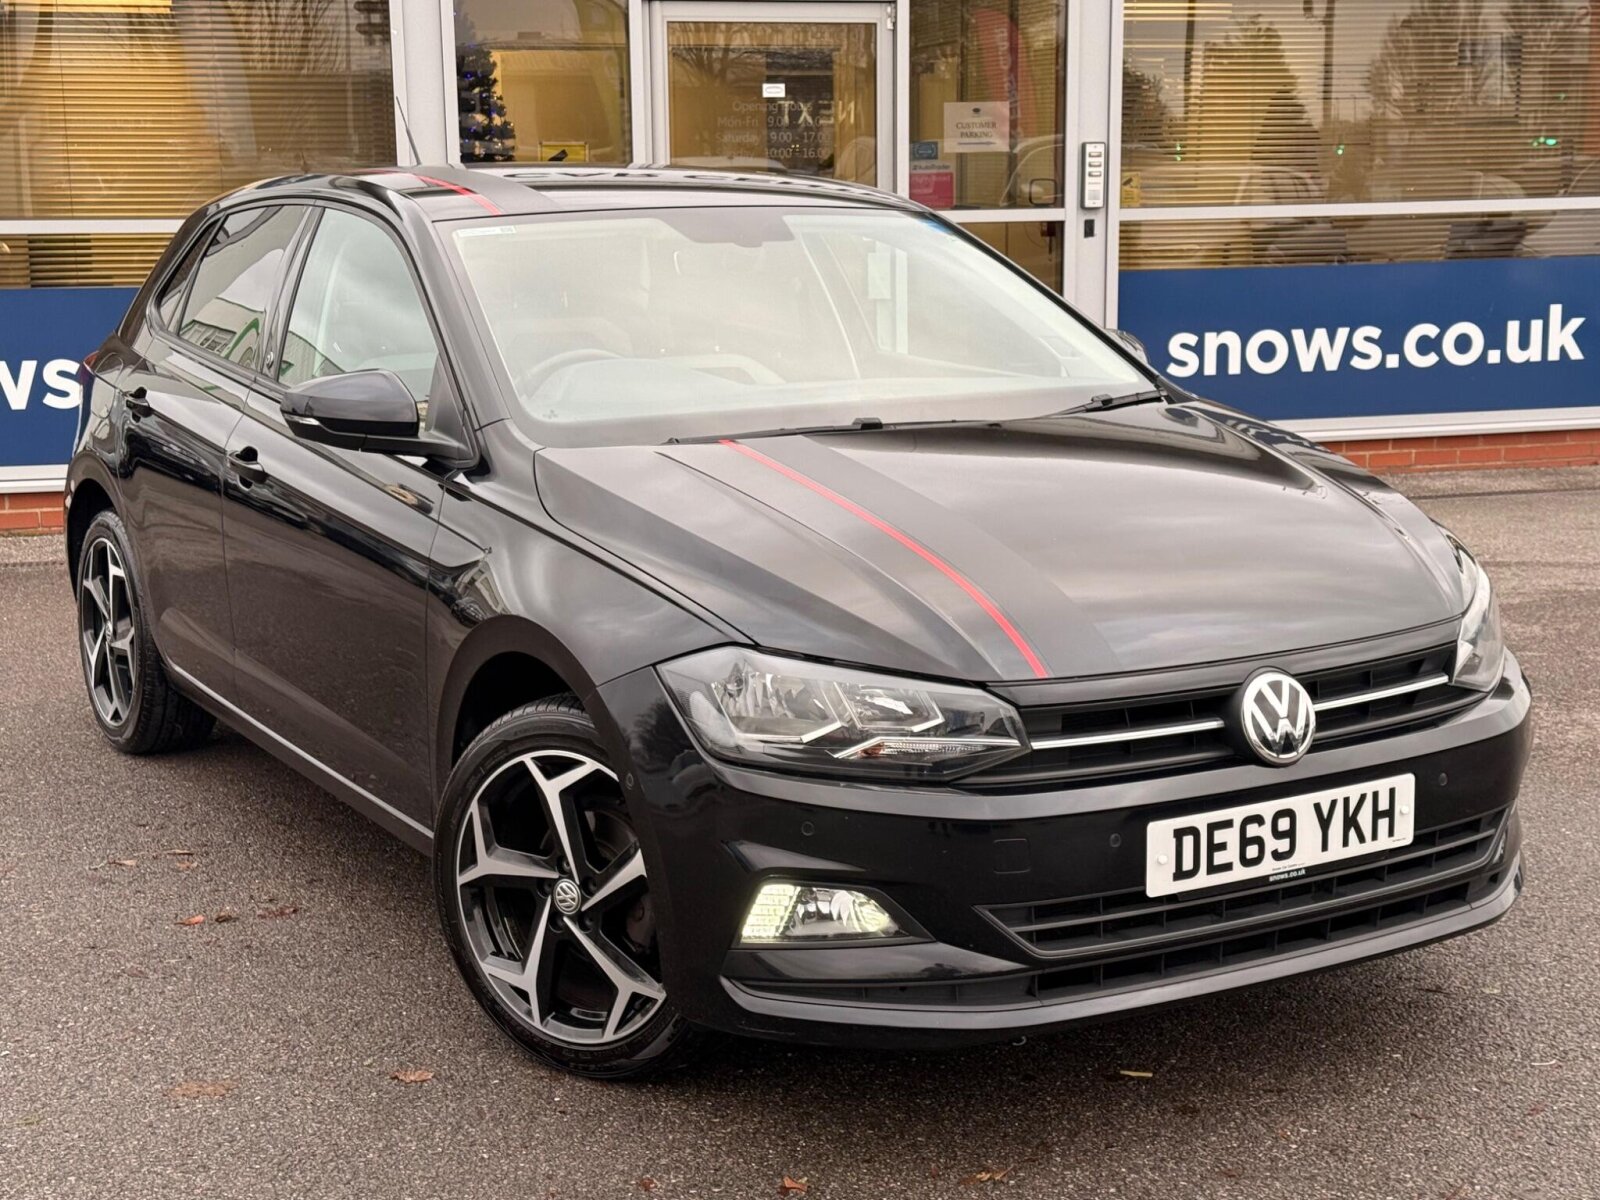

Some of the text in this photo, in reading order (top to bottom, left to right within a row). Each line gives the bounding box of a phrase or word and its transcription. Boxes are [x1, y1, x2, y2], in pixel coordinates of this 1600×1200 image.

[732, 100, 778, 114] Opening
[717, 116, 759, 127] Mon-Fri
[955, 121, 997, 130] CUSTOMER
[715, 132, 760, 145] Saturday
[769, 131, 793, 143] 9.00
[1166, 303, 1587, 378] snows.co.uk
[1172, 786, 1396, 882] DE69 YKH
